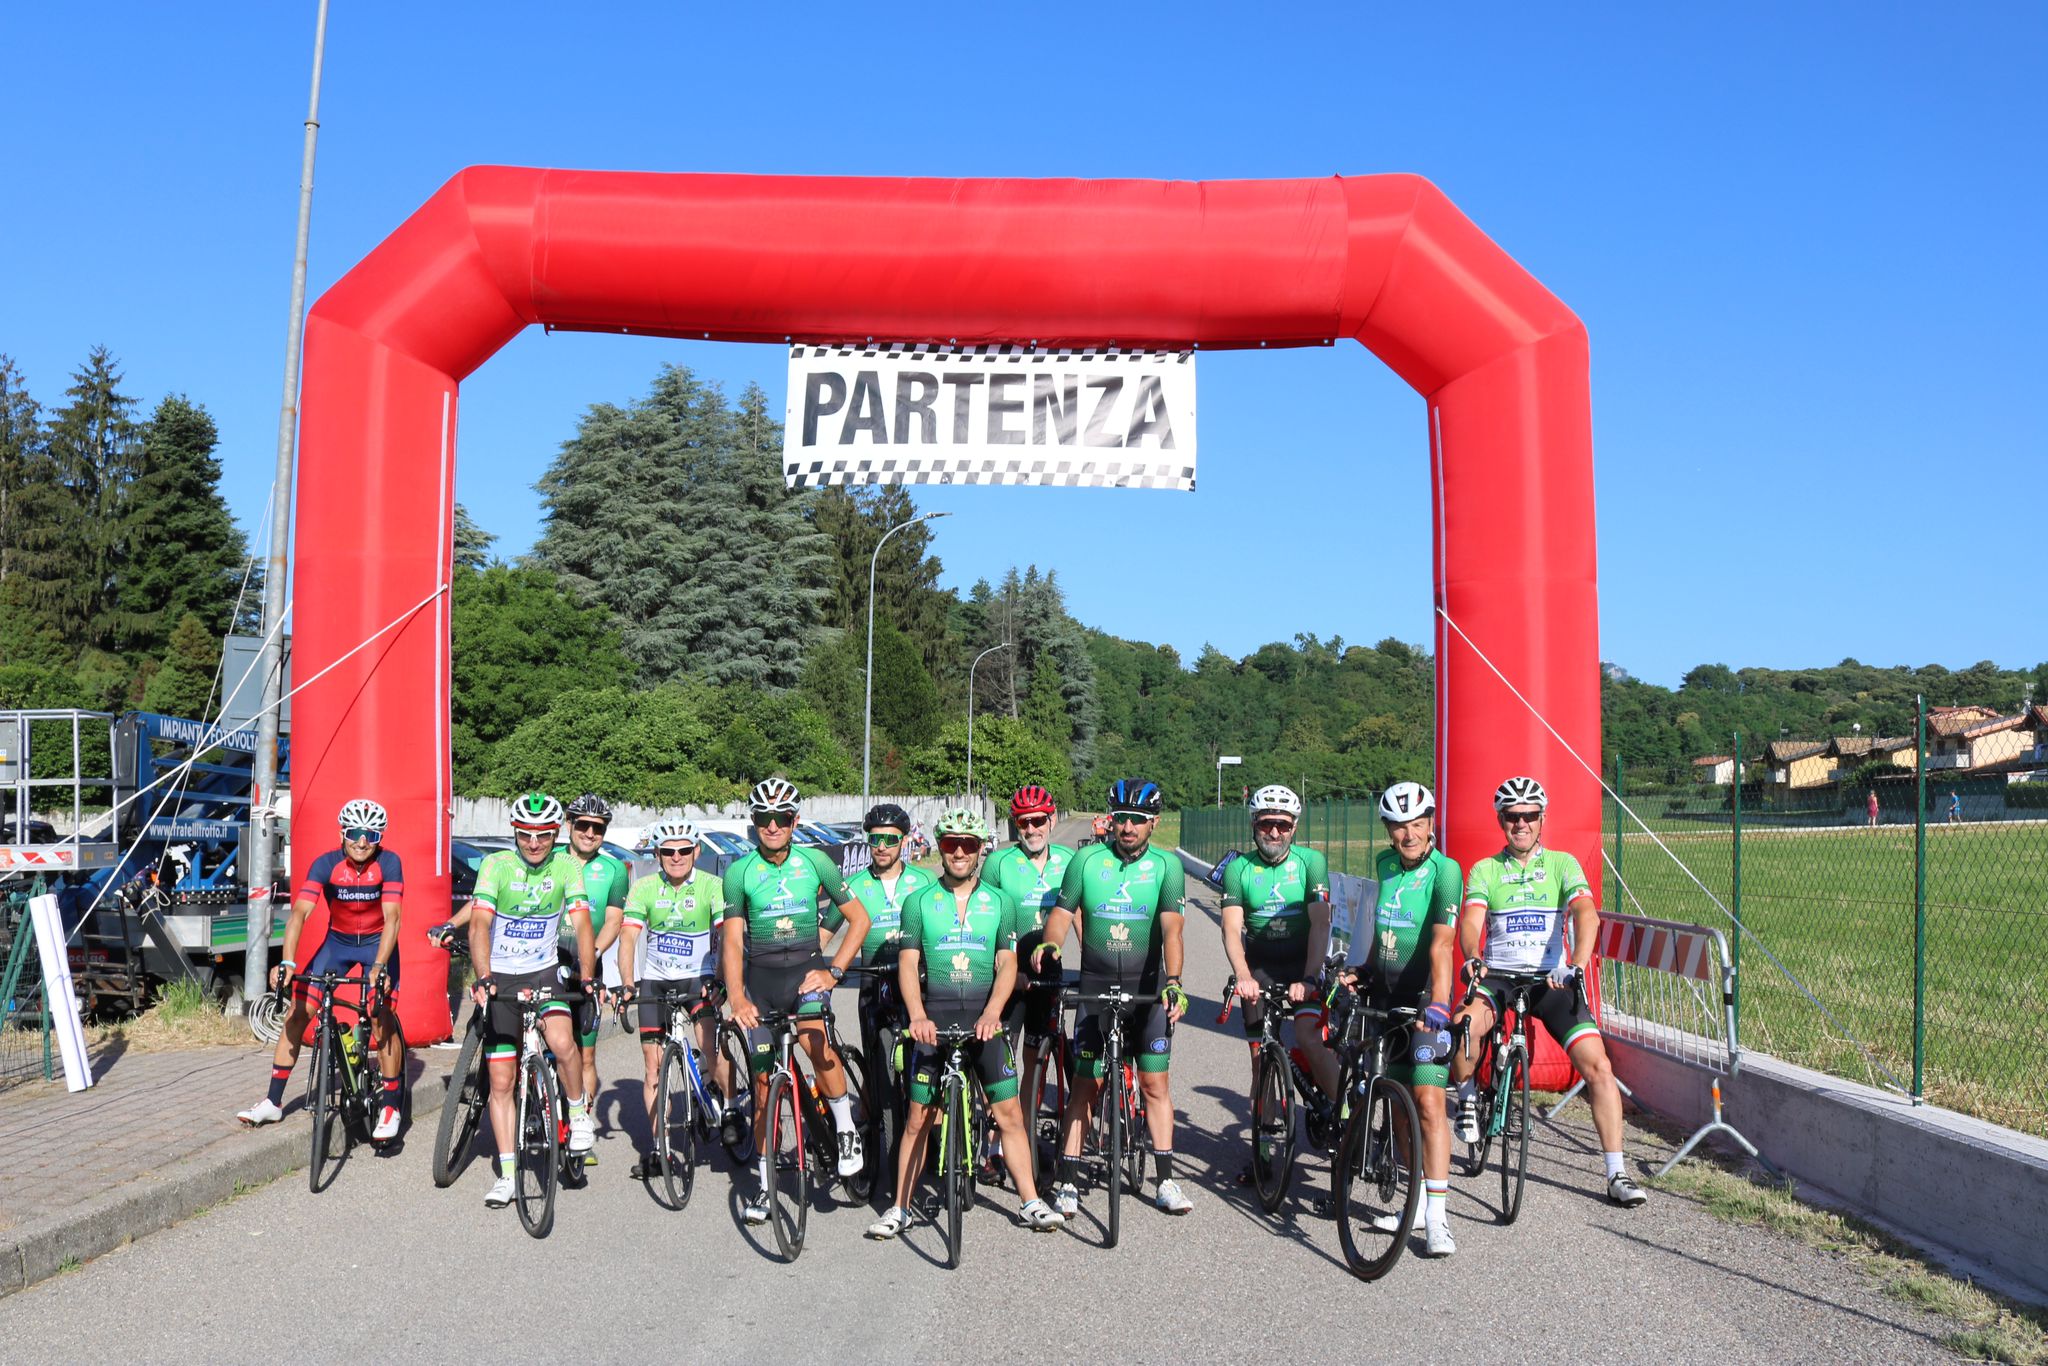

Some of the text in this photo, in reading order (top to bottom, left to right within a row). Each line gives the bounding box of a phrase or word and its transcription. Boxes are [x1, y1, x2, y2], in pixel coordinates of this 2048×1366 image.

[801, 370, 1177, 450] PARTENZA
[1508, 916, 1544, 924] MAGMA
[507, 922, 545, 930] MAGMA
[659, 936, 692, 948] MAGMA
